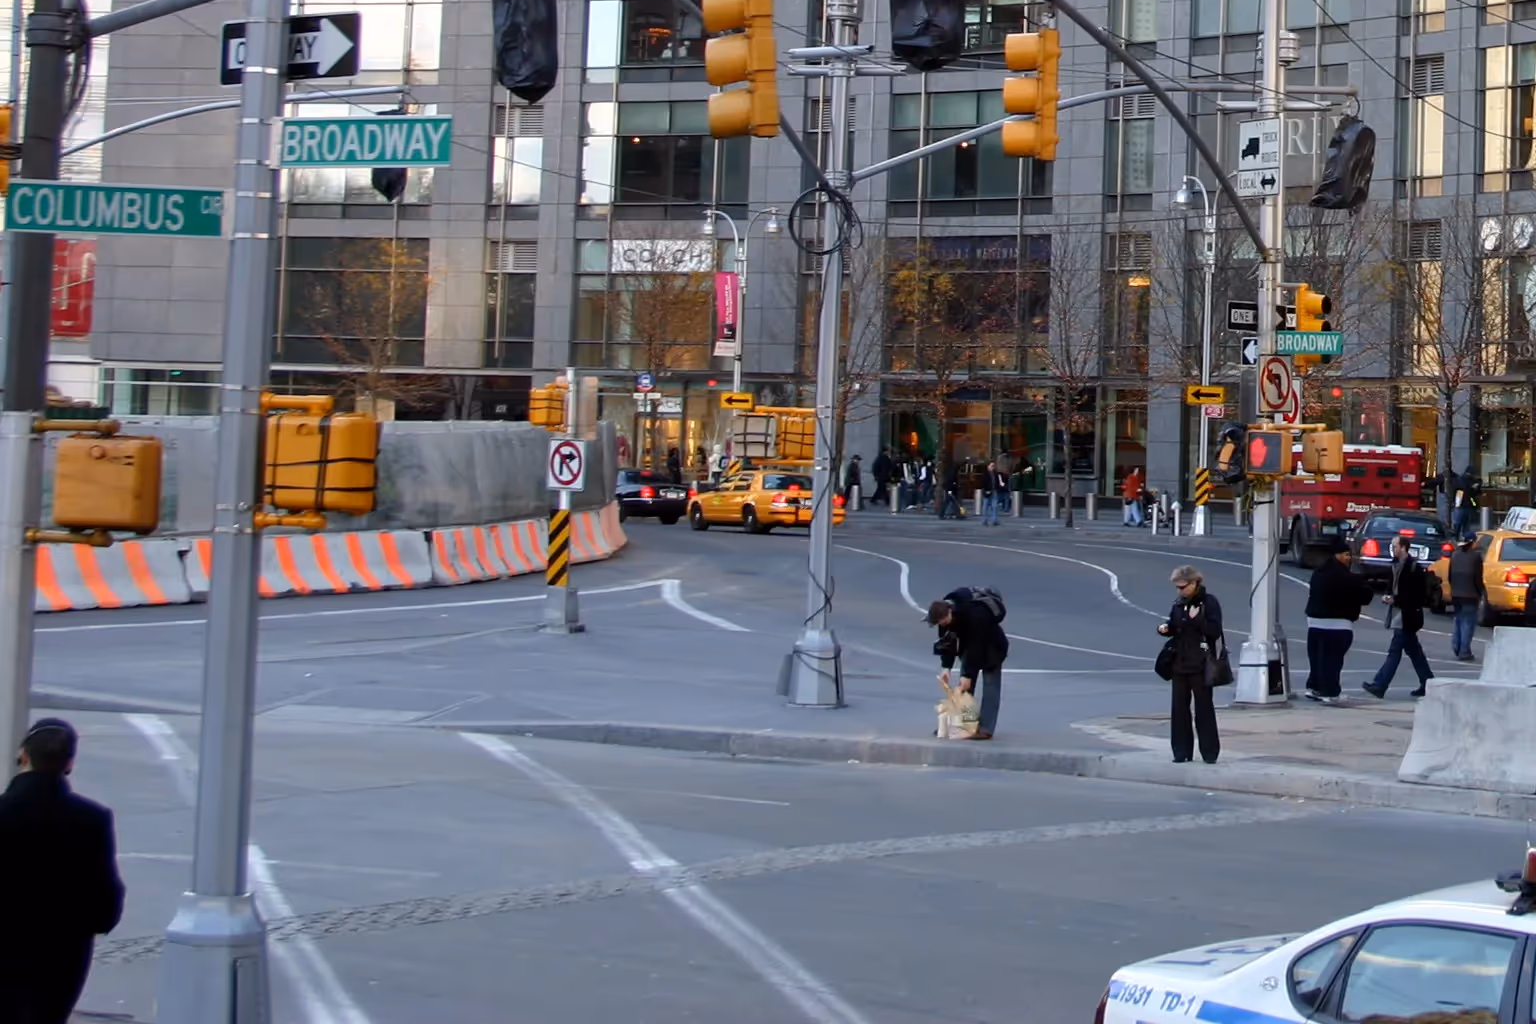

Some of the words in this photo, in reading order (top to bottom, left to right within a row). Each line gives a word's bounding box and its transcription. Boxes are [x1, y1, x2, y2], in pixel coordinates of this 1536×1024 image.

[290, 35, 318, 61] AY
[283, 122, 449, 162] BROADWAY
[1239, 177, 1257, 191] LOCAL
[12, 186, 185, 232] COLUMBUS
[200, 195, 223, 216] CIR
[623, 248, 702, 264] COCH
[1233, 310, 1250, 323] ONE
[1277, 334, 1340, 352] BROADWAY
[1160, 989, 1197, 1016] TD-1
